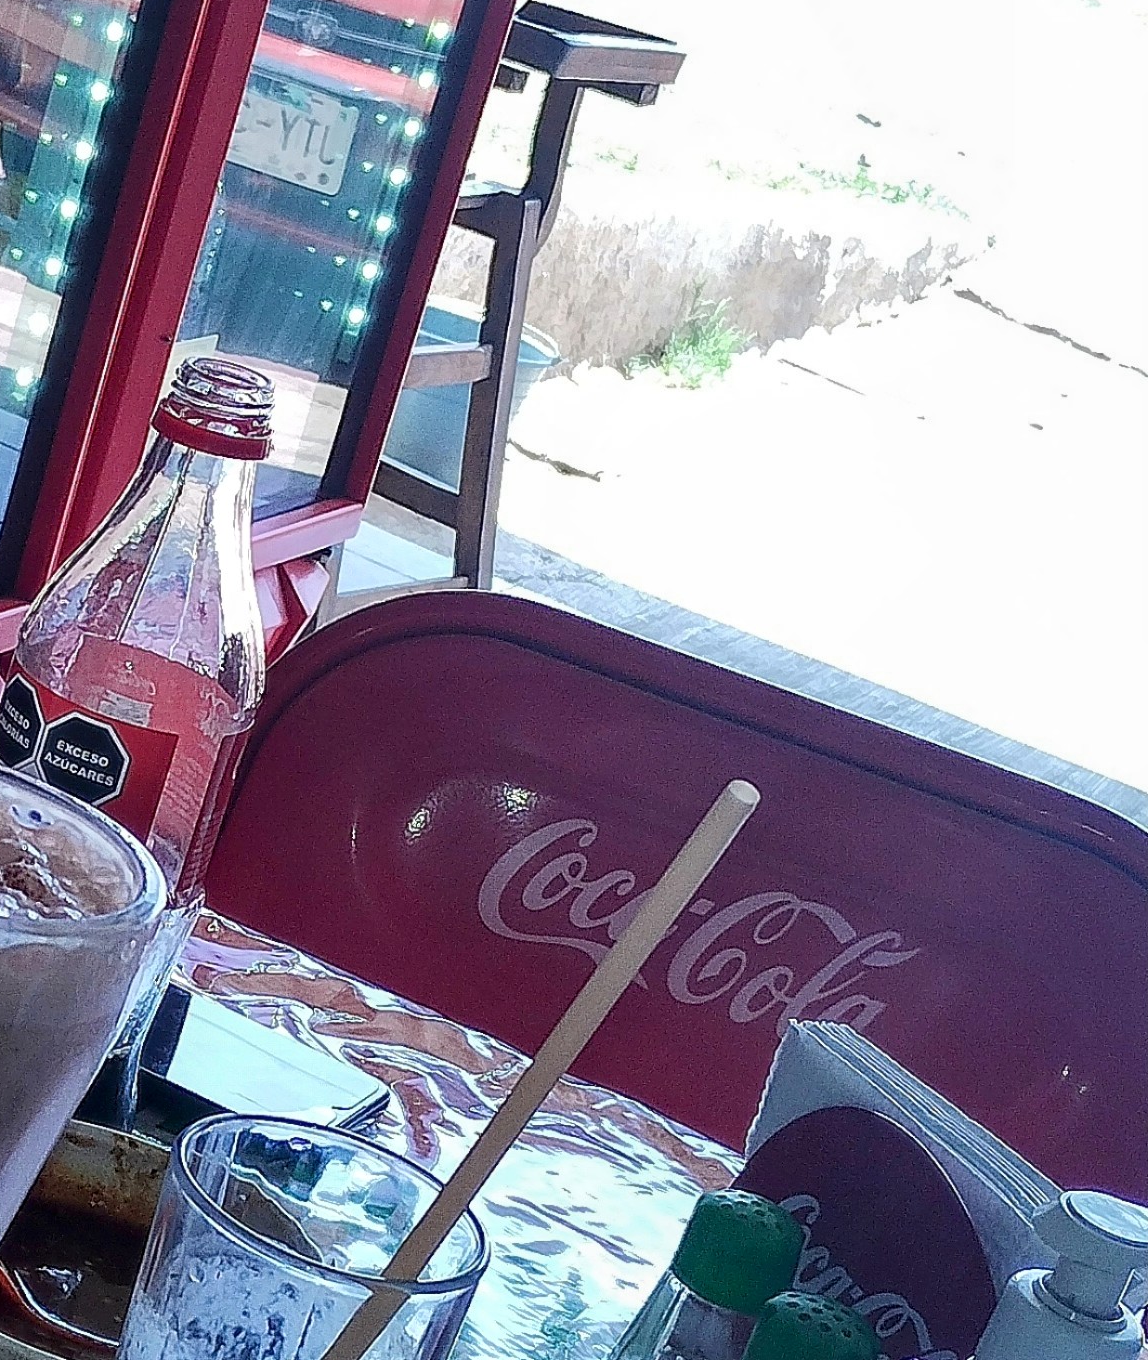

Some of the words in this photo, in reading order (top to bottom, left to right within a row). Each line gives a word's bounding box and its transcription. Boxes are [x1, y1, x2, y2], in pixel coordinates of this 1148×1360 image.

[234, 98, 336, 167] -YTL
[3, 698, 31, 730] EXCESO
[43, 750, 116, 790] AZÚCARES
[55, 738, 110, 768] EXCESO
